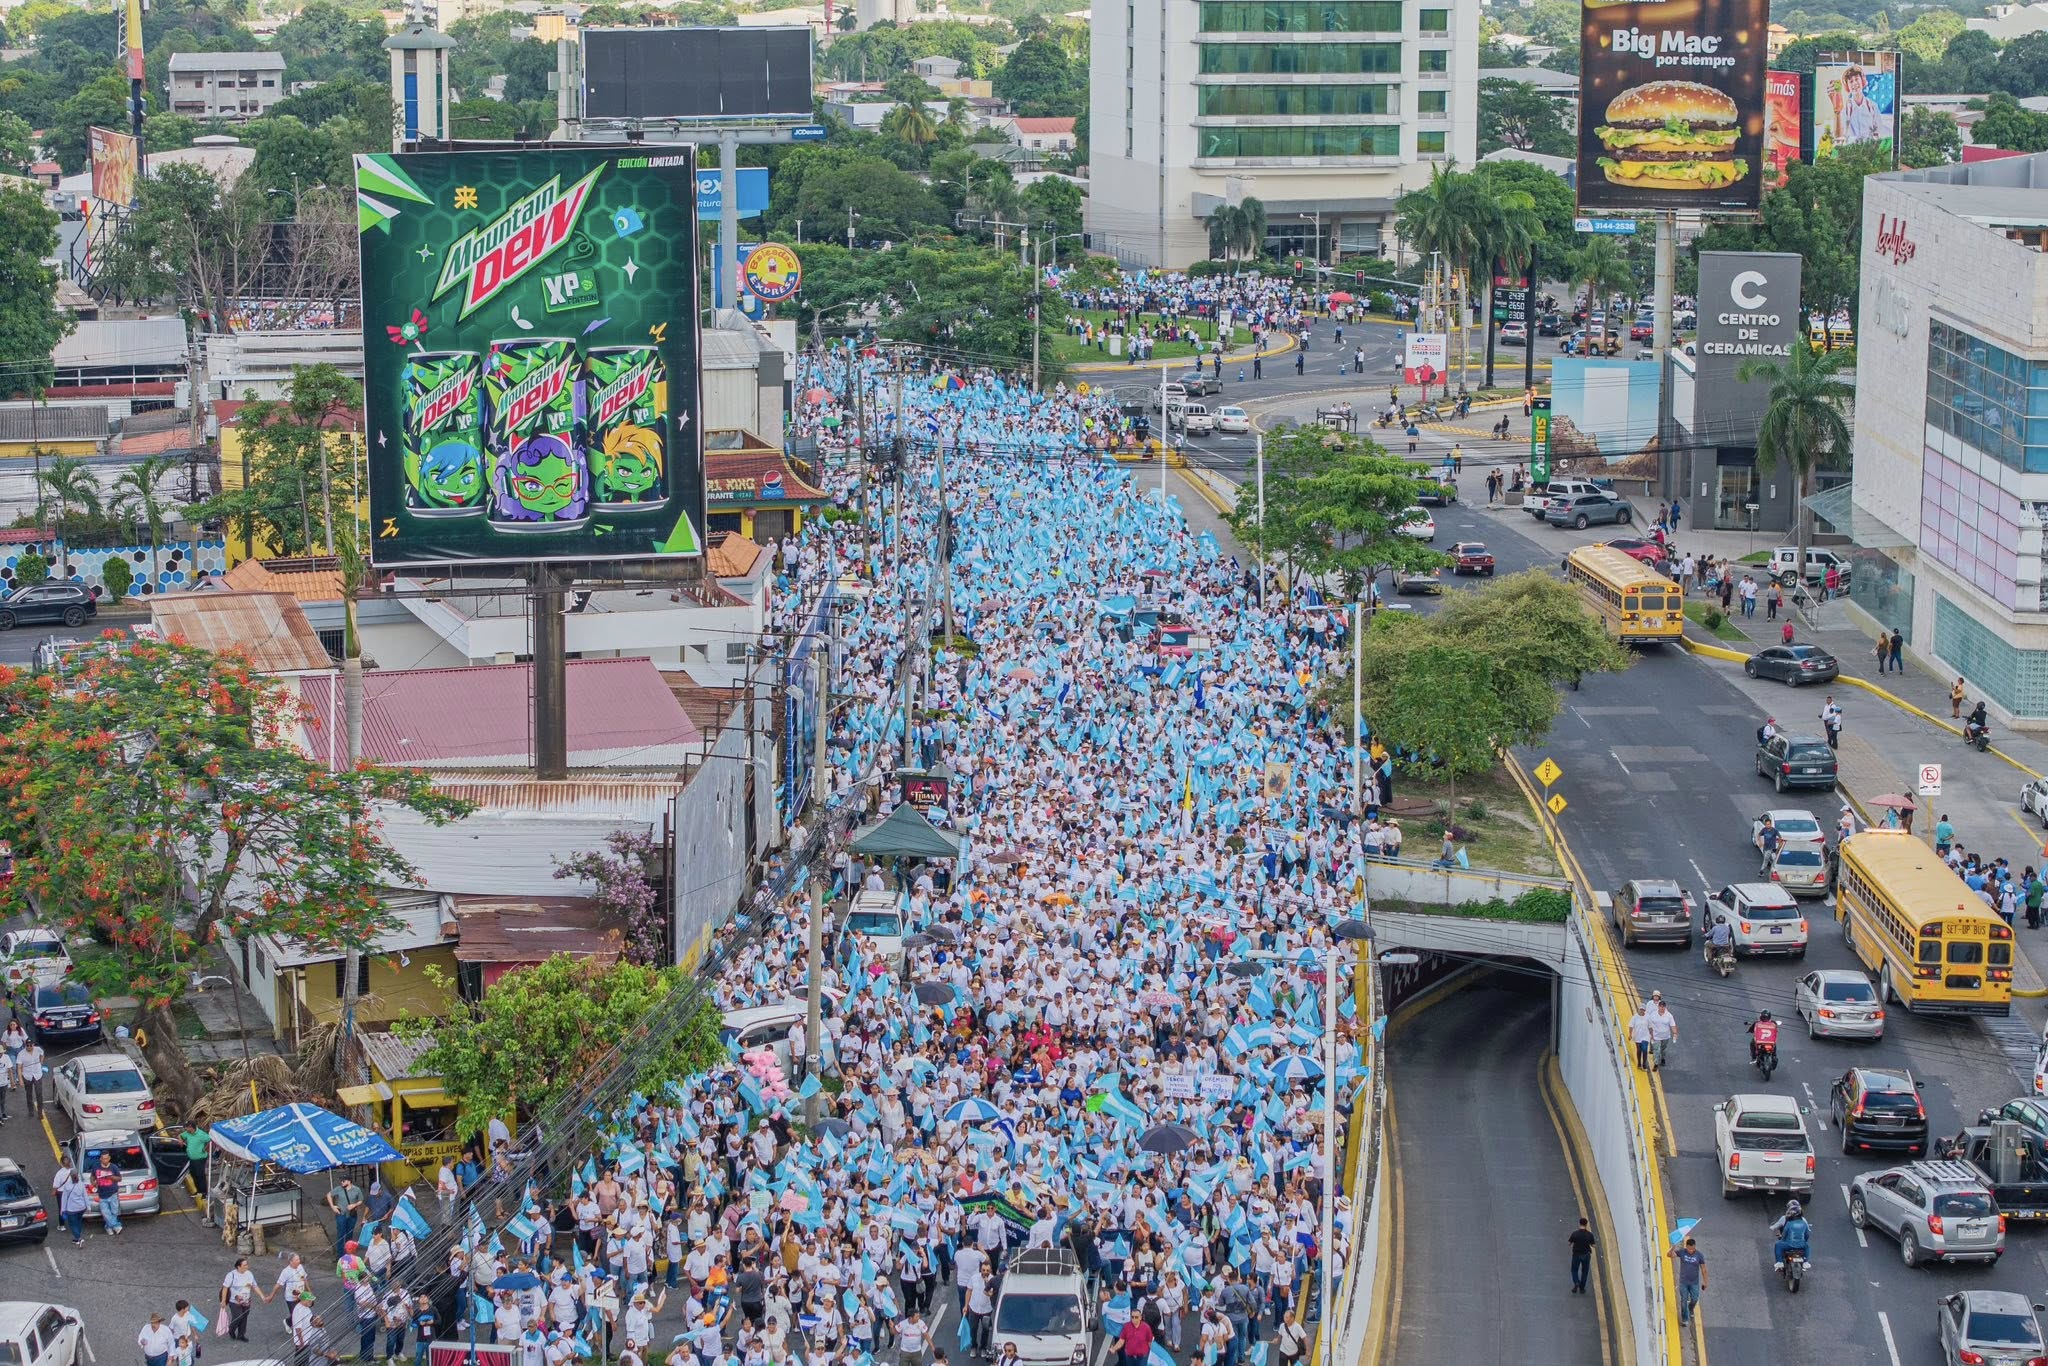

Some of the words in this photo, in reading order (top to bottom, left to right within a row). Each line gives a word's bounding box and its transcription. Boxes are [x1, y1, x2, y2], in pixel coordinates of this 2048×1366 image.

[1612, 27, 1656, 59] Big
[1660, 30, 1718, 54] Mac
[1656, 56, 1679, 68] por
[1681, 54, 1735, 69] siempre
[794, 128, 824, 136] JCDecaux
[617, 157, 648, 169] EDICIÓN
[648, 155, 685, 168] LIMITADA
[442, 184, 555, 287] Mountain
[750, 249, 794, 270] Baleadas
[543, 272, 579, 306] XP
[749, 275, 795, 296] EXPRESS
[1718, 312, 1781, 326] CENTRO
[1738, 328, 1759, 341] DE
[1703, 342, 1793, 357] CERAMICAS
[1535, 415, 1547, 476] SUBWAY
[1946, 924, 1971, 935] SET-UP
[1973, 925, 1986, 936] BUS
[424, 1146, 435, 1155] DE
[436, 1144, 462, 1155] LLAVES
